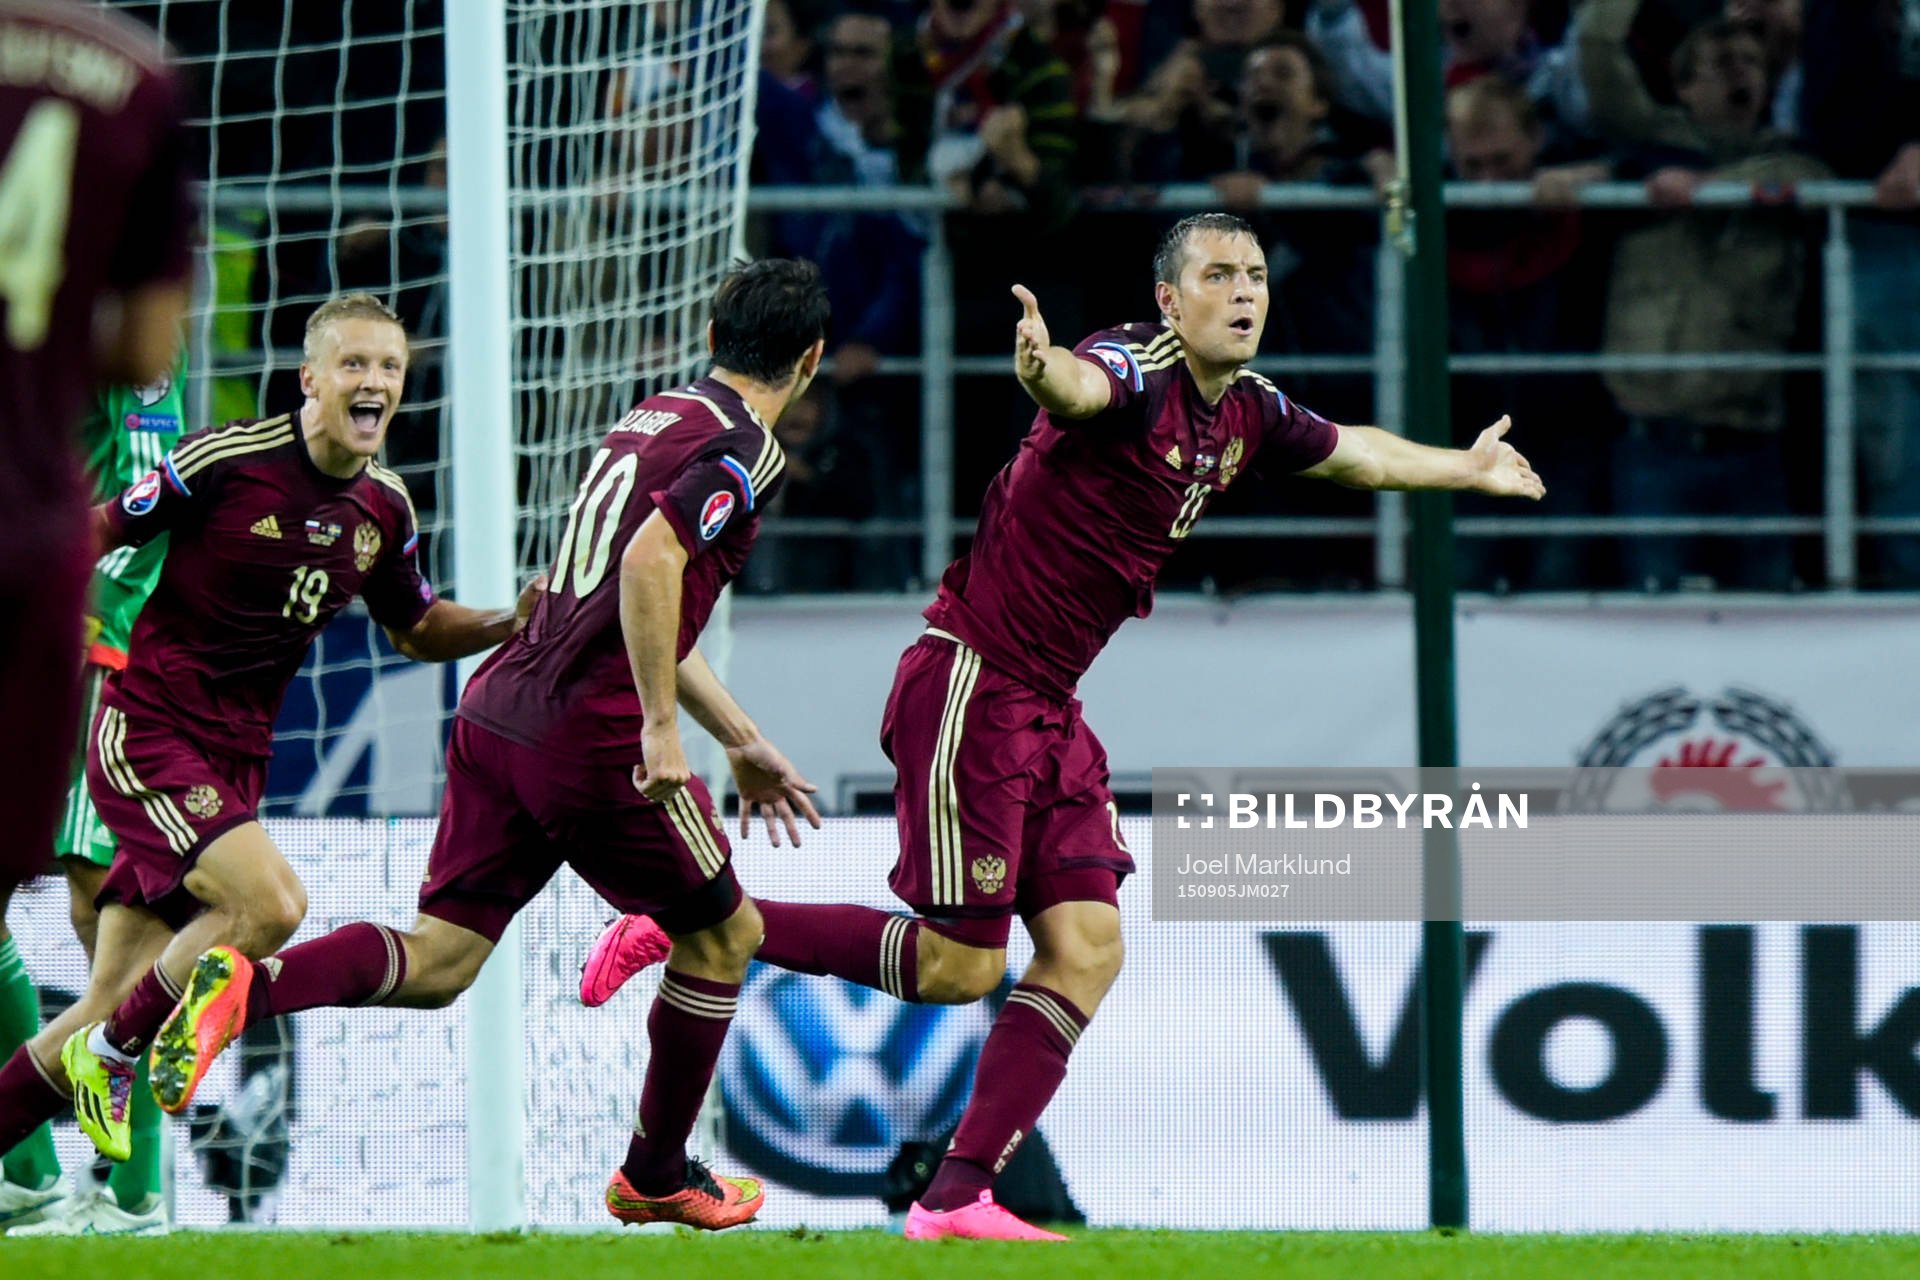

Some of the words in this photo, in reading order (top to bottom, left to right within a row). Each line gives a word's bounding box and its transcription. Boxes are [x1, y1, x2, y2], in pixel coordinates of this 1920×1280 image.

[550, 448, 638, 599] 10
[1168, 482, 1212, 538] 22
[282, 566, 329, 624] 19
[1258, 924, 1920, 1122] Volk
